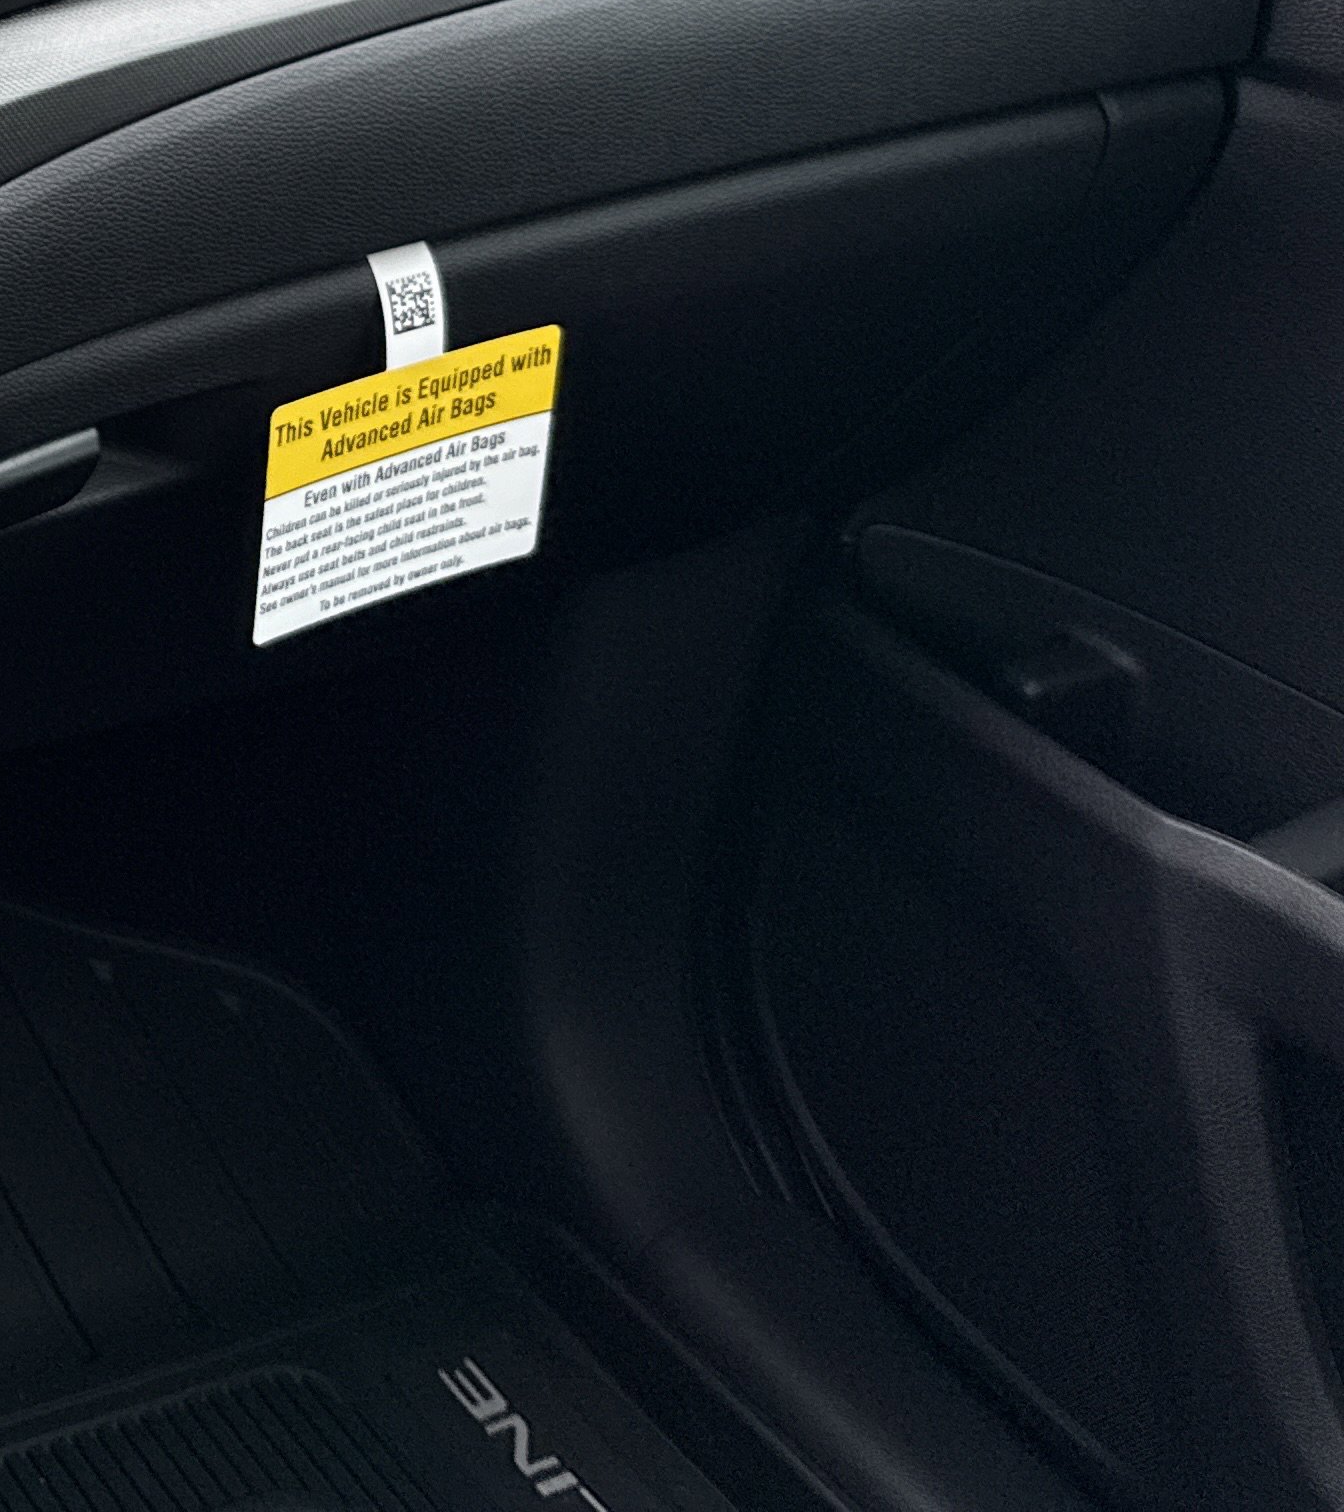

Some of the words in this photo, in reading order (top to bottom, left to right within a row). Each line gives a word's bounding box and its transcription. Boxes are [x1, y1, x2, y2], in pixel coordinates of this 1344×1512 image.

[275, 416, 314, 447] This
[320, 392, 389, 431] Vehicle
[395, 384, 412, 407] is
[418, 354, 505, 400] Equipped
[511, 344, 552, 373] with
[321, 412, 412, 462] Advanced
[417, 403, 446, 429] Air
[450, 391, 497, 419] Bags
[266, 517, 308, 541] Children
[308, 510, 327, 525] can
[328, 504, 342, 518] be
[343, 492, 372, 512] killed
[373, 490, 384, 503] or
[385, 474, 430, 498] seriously
[431, 461, 467, 483] injured
[468, 459, 481, 473] by
[483, 454, 500, 467] the
[501, 448, 517, 462] air
[518, 444, 540, 458] bag.
[304, 485, 338, 508] Even
[341, 471, 371, 494] with
[374, 447, 442, 483] Advanced
[445, 440, 468, 460] Air
[470, 431, 506, 453] Bags
[263, 559, 293, 578] Never
[293, 549, 311, 569] put
[311, 549, 319, 560] a
[320, 528, 375, 557] rear-facing
[376, 518, 402, 536] child
[404, 510, 426, 527] seat
[428, 507, 438, 518] in
[439, 502, 456, 515] the
[265, 545, 283, 560] The
[285, 533, 309, 552] back
[310, 524, 333, 542] seat
[334, 521, 344, 534] is
[346, 515, 362, 529] the
[364, 503, 394, 523] safest
[396, 494, 423, 514] place
[425, 489, 440, 502] for
[441, 476, 487, 497] children.
[259, 600, 278, 615] See
[279, 584, 318, 607] owner's
[319, 568, 356, 592] manual
[357, 565, 371, 578] for
[372, 555, 399, 572] more
[400, 535, 456, 562] information
[458, 526, 487, 545] about
[488, 522, 503, 536] air
[260, 575, 296, 597] Always
[298, 567, 316, 583] use
[317, 556, 340, 575] seat
[341, 548, 366, 566] belts
[368, 539, 387, 557] and
[389, 529, 414, 549] child
[320, 599, 331, 611] To
[333, 594, 346, 607] be
[348, 575, 391, 601] removed
[393, 573, 405, 586] by
[407, 563, 439, 581] owner
